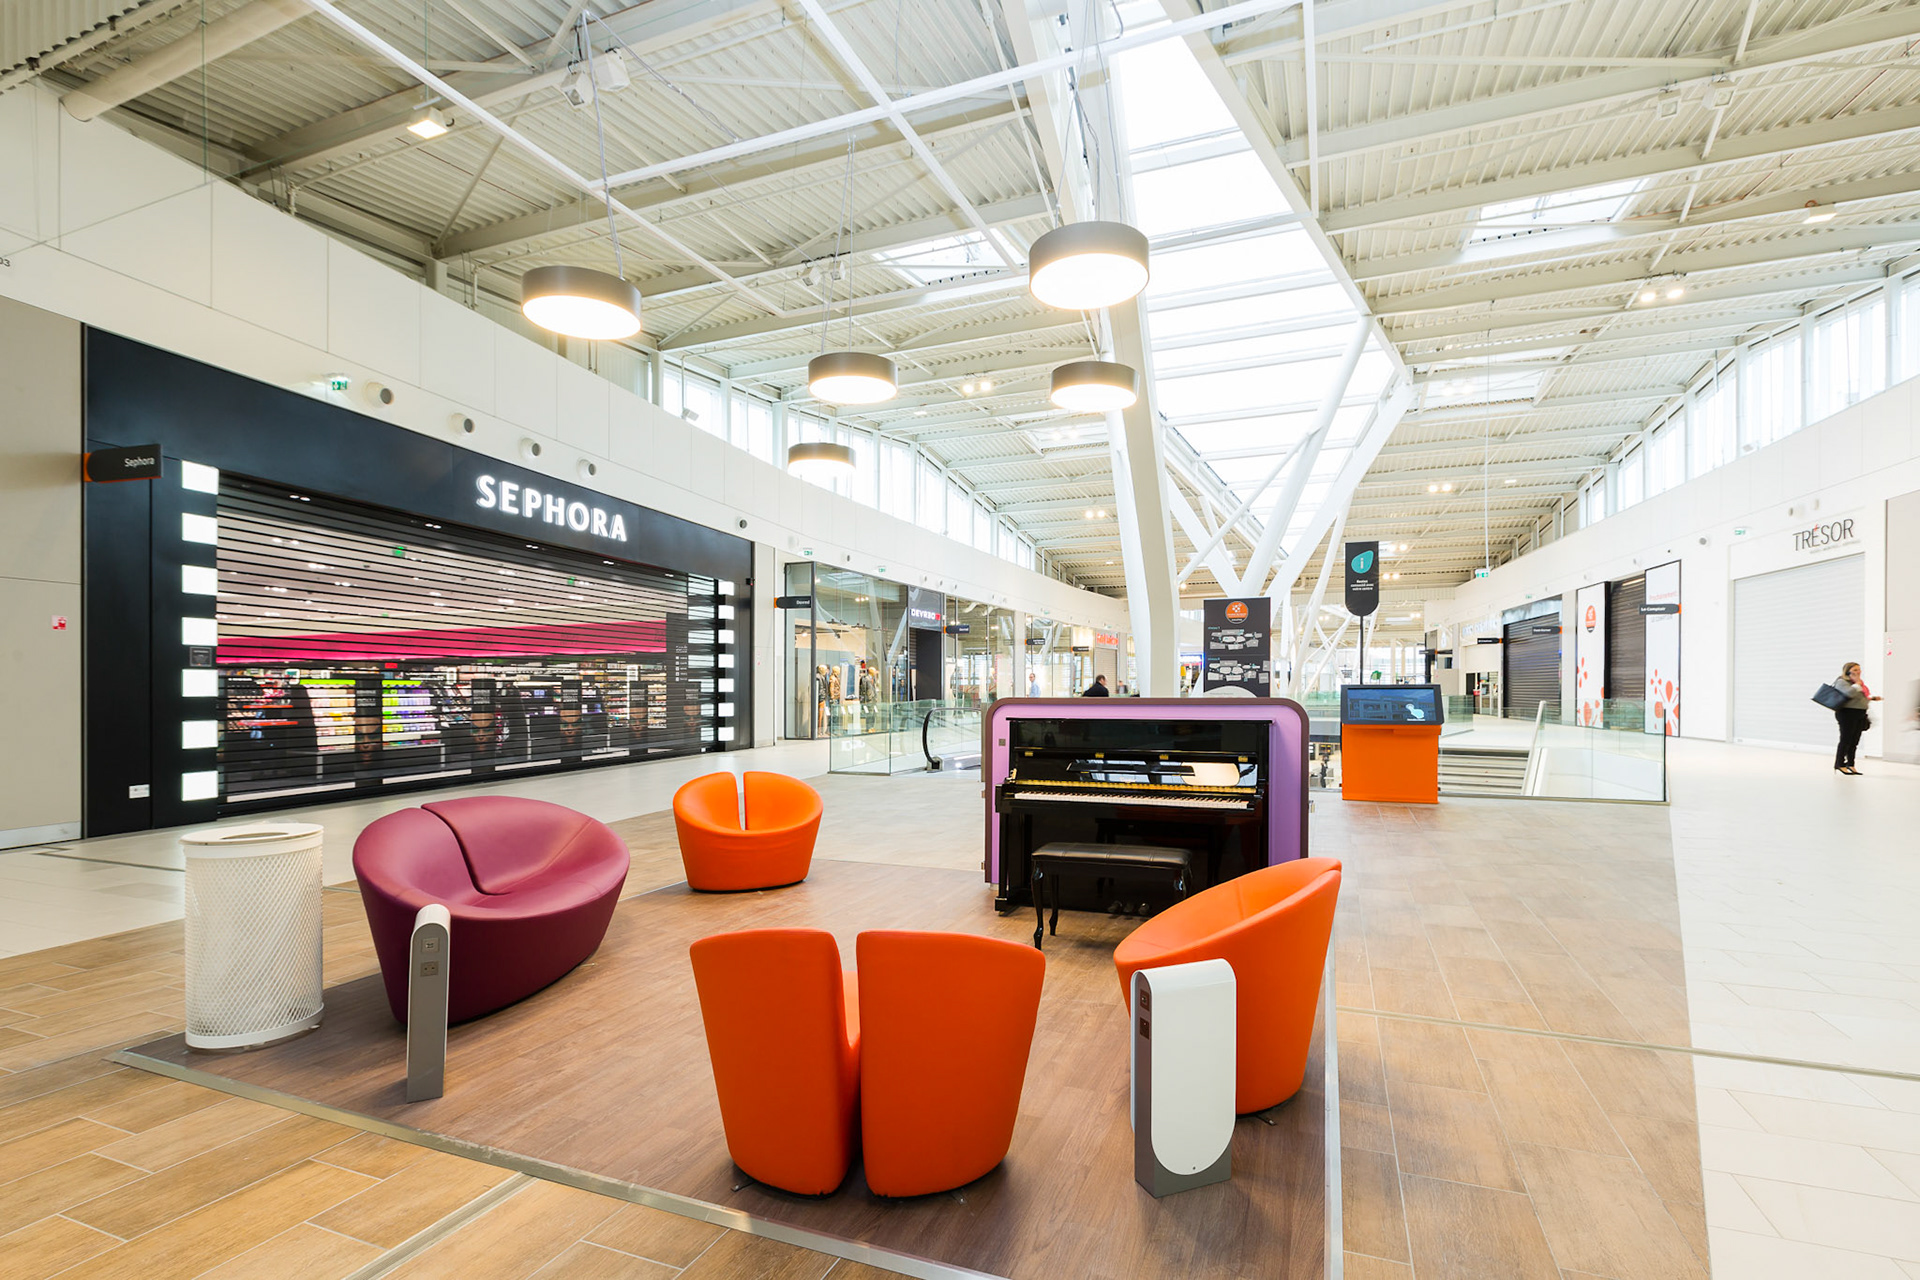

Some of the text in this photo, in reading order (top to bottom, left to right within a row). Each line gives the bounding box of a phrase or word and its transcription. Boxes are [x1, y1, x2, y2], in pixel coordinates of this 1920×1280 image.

[124, 457, 155, 468] Sephora
[476, 475, 627, 542] SEPHORA
[1792, 518, 1854, 551] TRÉSOR
